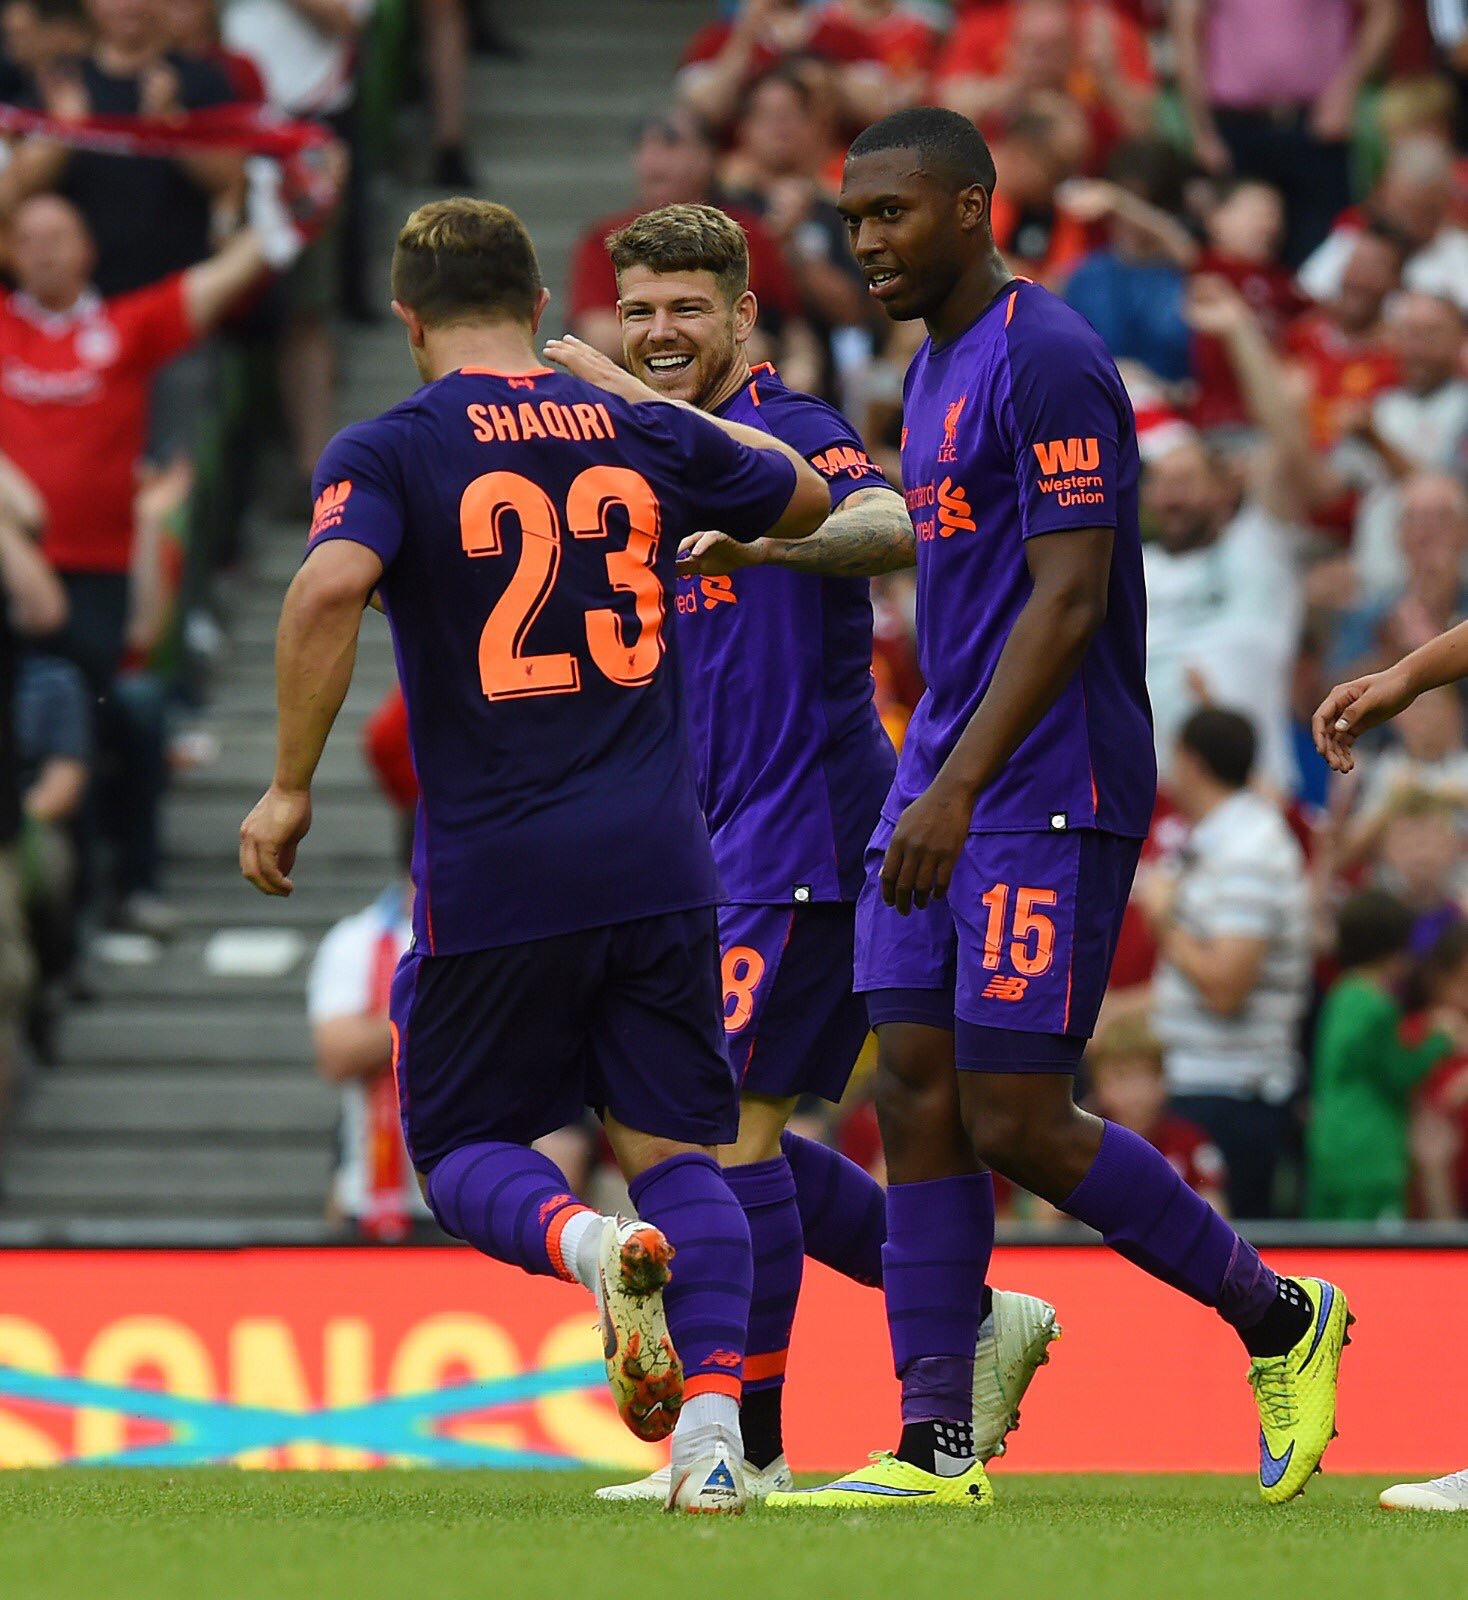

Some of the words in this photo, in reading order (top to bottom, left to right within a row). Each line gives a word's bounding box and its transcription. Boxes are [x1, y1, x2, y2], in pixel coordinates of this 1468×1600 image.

[466, 400, 617, 443] SHAQIRI
[1032, 437, 1100, 475] WU
[1037, 475, 1103, 493] Western
[1057, 488, 1105, 507] Union
[459, 464, 667, 702] 23
[982, 882, 1057, 977] 15
[719, 944, 766, 1034] 8
